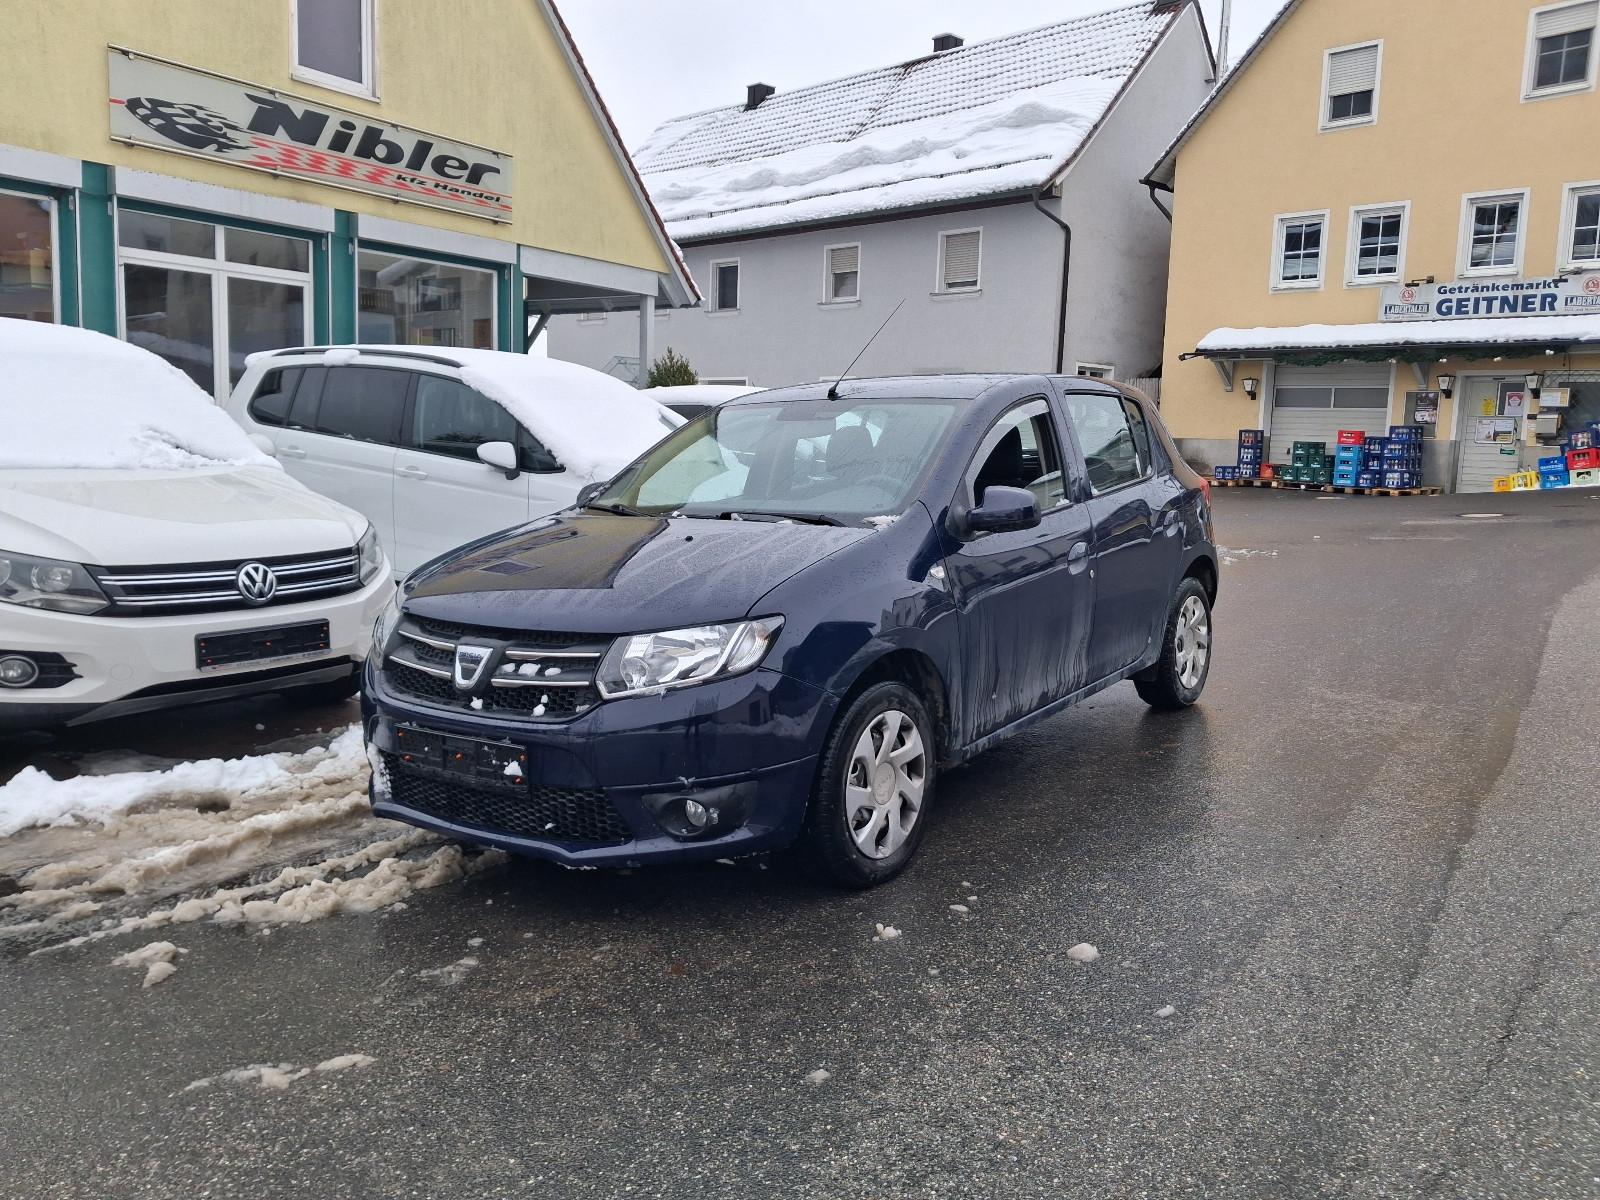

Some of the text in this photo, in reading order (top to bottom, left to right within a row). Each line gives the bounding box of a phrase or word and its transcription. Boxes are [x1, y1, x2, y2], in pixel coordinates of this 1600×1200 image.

[243, 93, 500, 186] Nibler
[434, 183, 500, 202] Handel
[1437, 279, 1560, 295] Getränkemarkt
[1436, 293, 1558, 316] GEITNER
